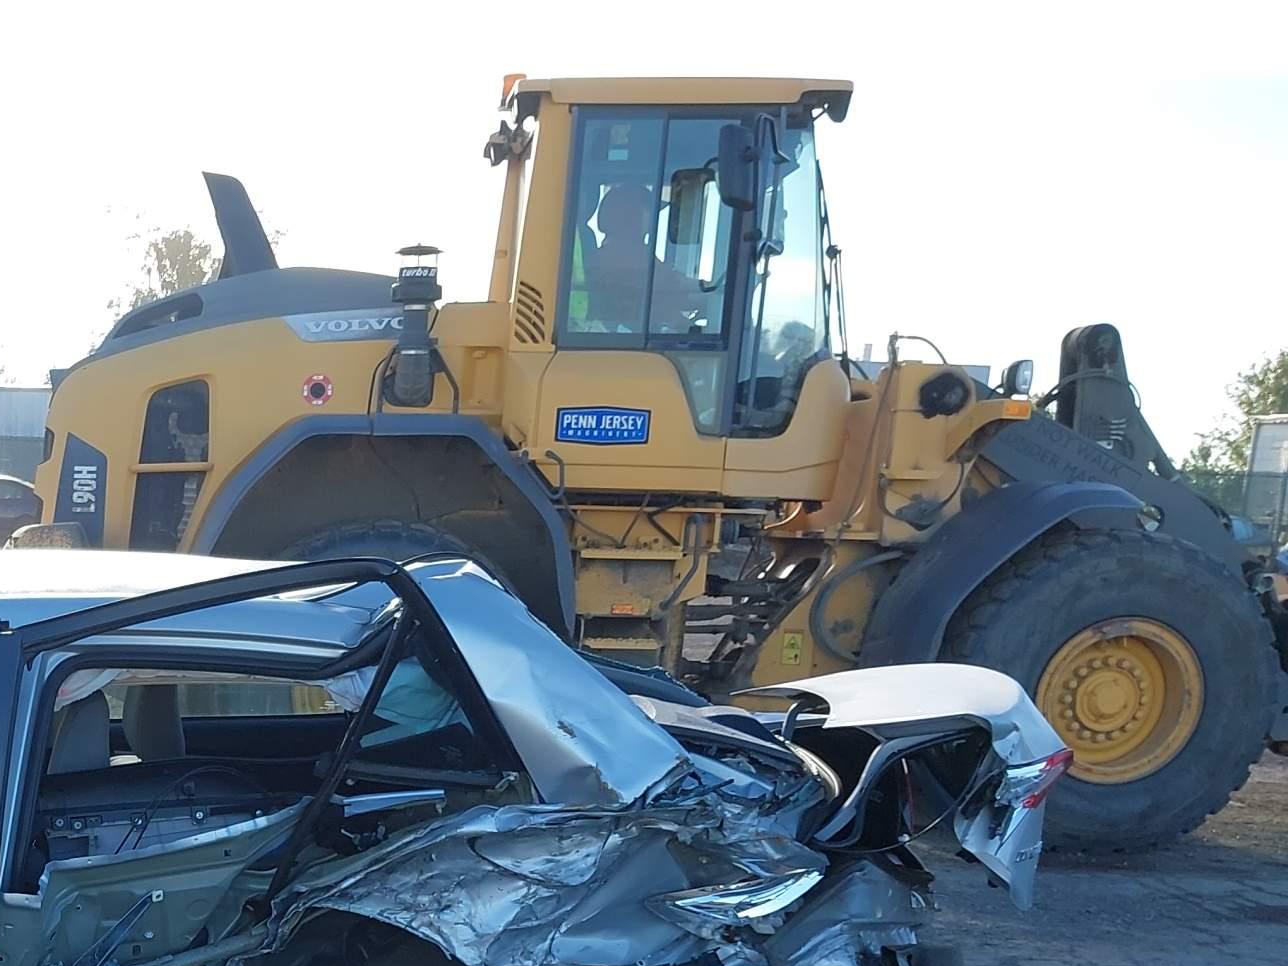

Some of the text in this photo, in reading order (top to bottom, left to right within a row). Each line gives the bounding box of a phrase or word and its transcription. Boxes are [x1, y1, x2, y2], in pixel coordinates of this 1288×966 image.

[402, 267, 428, 277] turbo
[563, 414, 643, 430] PENN JERSEY
[72, 465, 97, 513] L90H
